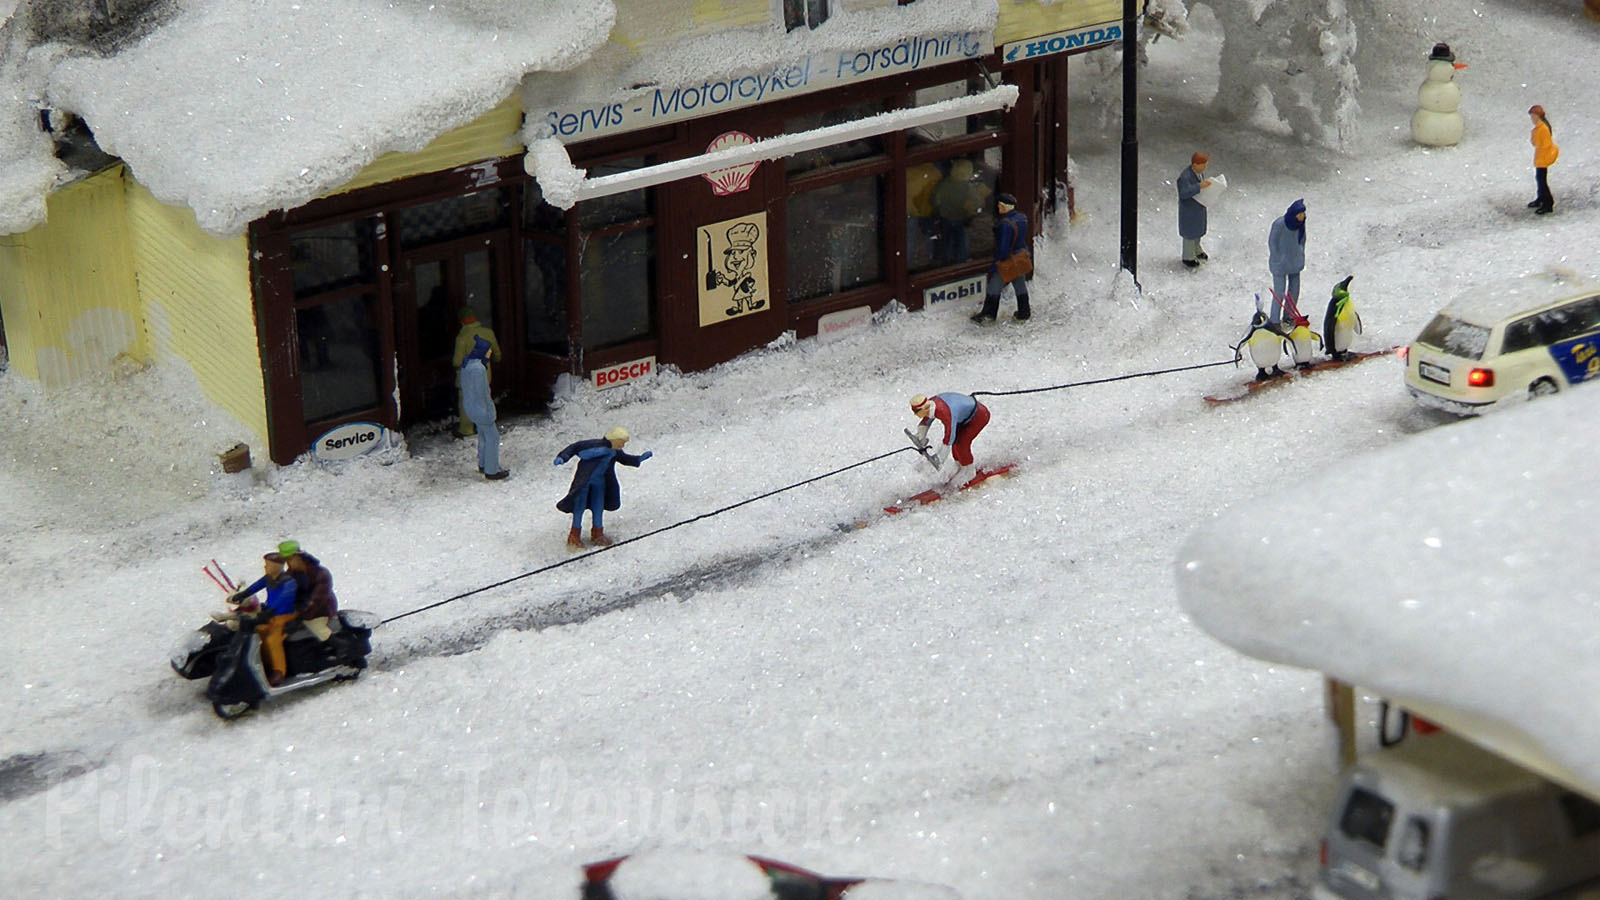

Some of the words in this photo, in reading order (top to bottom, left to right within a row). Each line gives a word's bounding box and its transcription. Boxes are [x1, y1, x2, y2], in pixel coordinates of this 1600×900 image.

[1025, 25, 1121, 57] HONDA
[548, 103, 624, 136] Servis
[652, 56, 811, 117] Motorcykel
[930, 280, 983, 305] Mobil
[596, 361, 651, 387] BOSCH
[325, 431, 376, 451] Service
